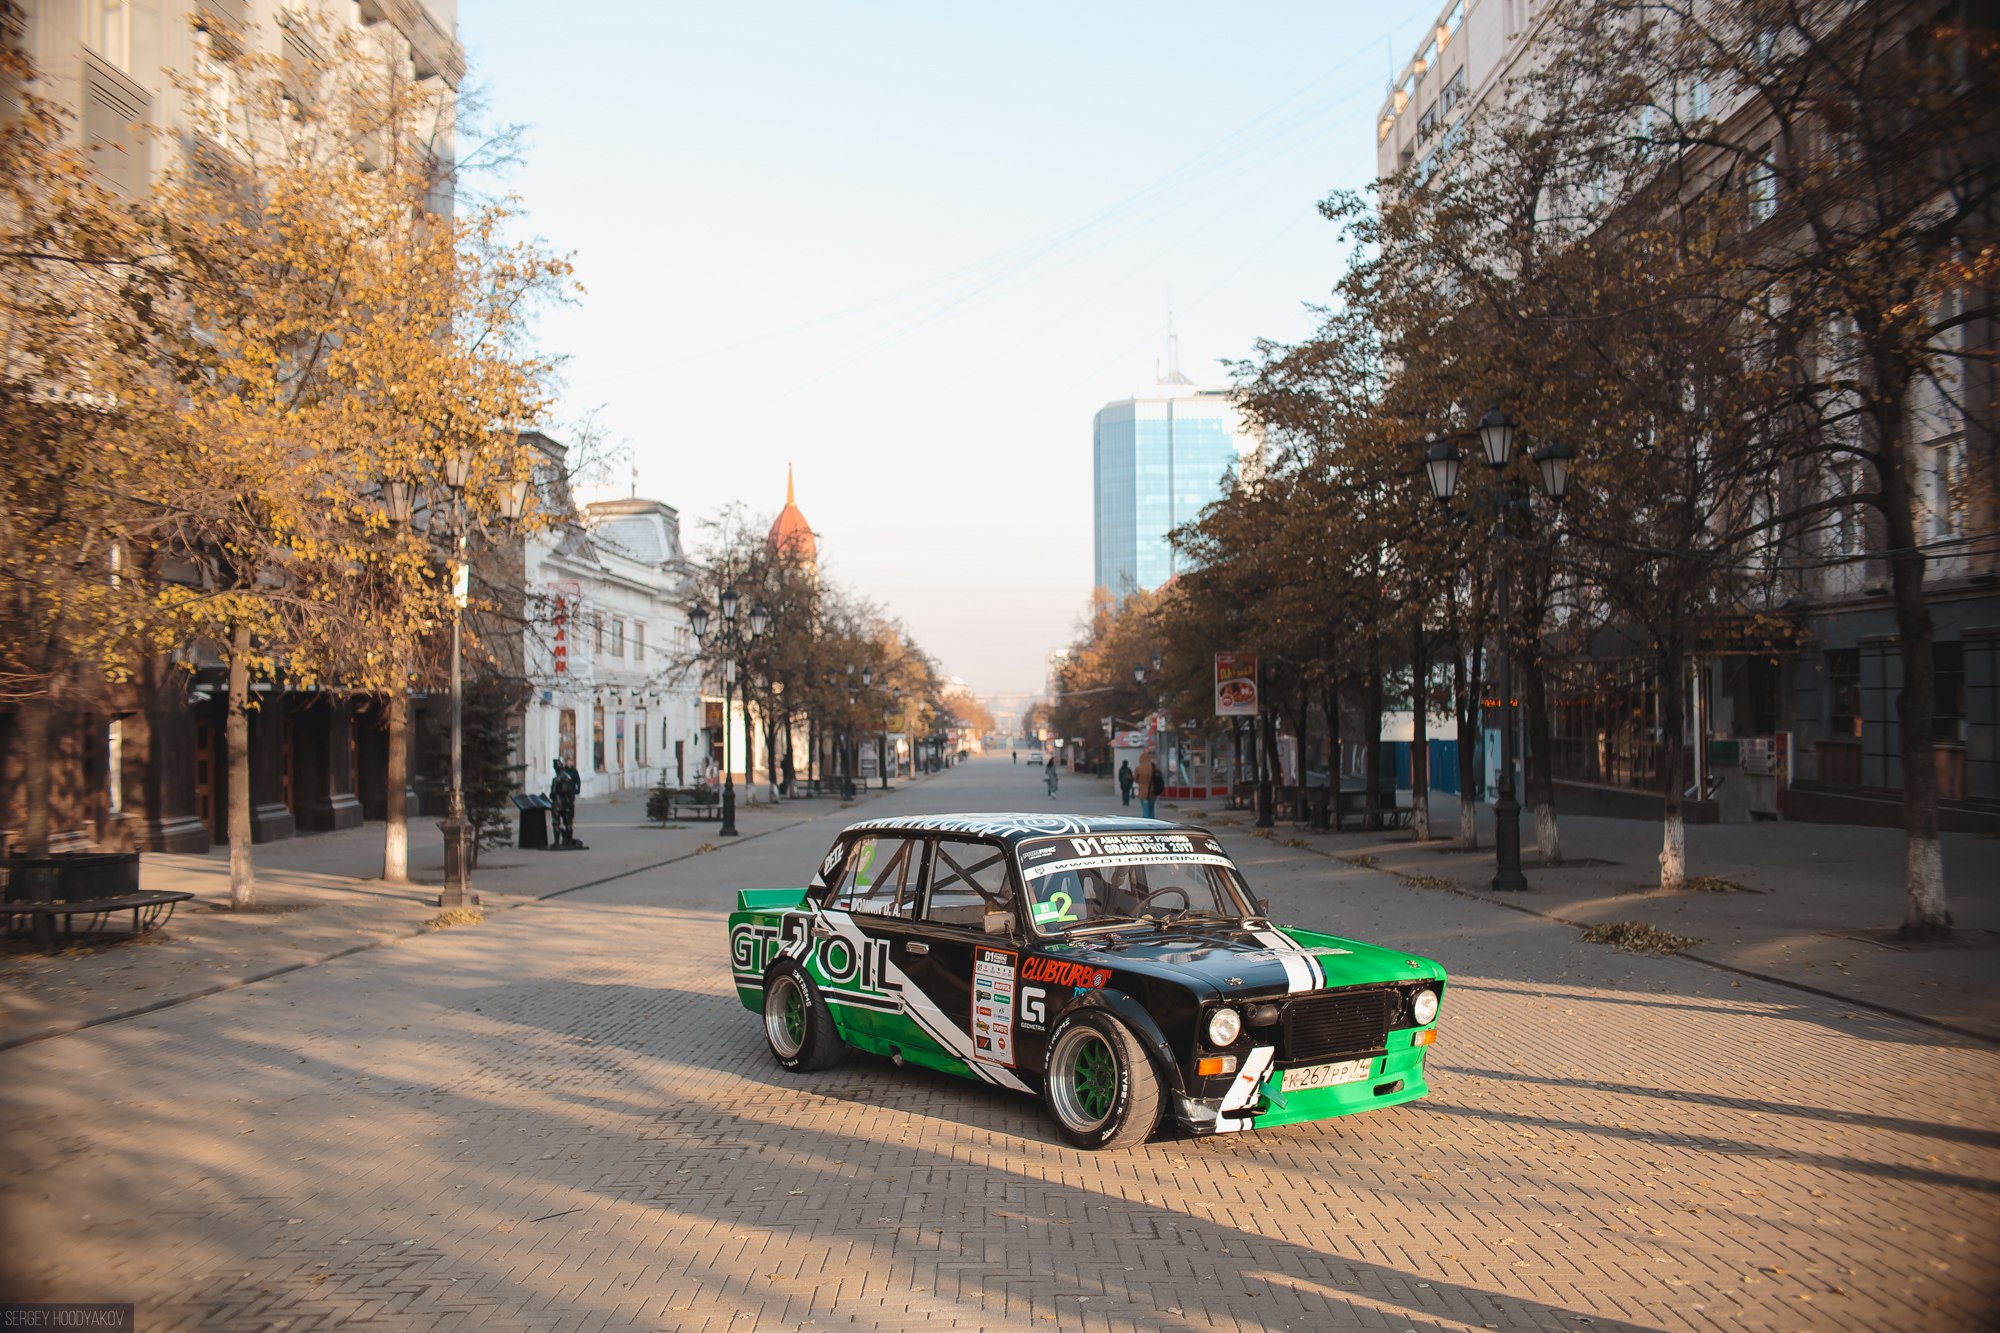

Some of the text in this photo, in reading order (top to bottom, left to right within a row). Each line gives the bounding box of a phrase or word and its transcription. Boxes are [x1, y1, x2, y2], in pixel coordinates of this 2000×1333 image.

[1070, 836, 1104, 856] D1
[1100, 836, 1121, 844] ASIA
[1120, 835, 1154, 844] PACIFIC
[1103, 843, 1144, 855] GRAND
[1142, 842, 1170, 853] PRIX
[1169, 842, 1194, 853] 2017
[856, 845, 876, 886] 2
[1050, 892, 1078, 923] 2
[731, 923, 903, 995] GT OIL
[984, 951, 994, 962] D1
[1020, 1022, 1046, 1031] GEOMETRIA
